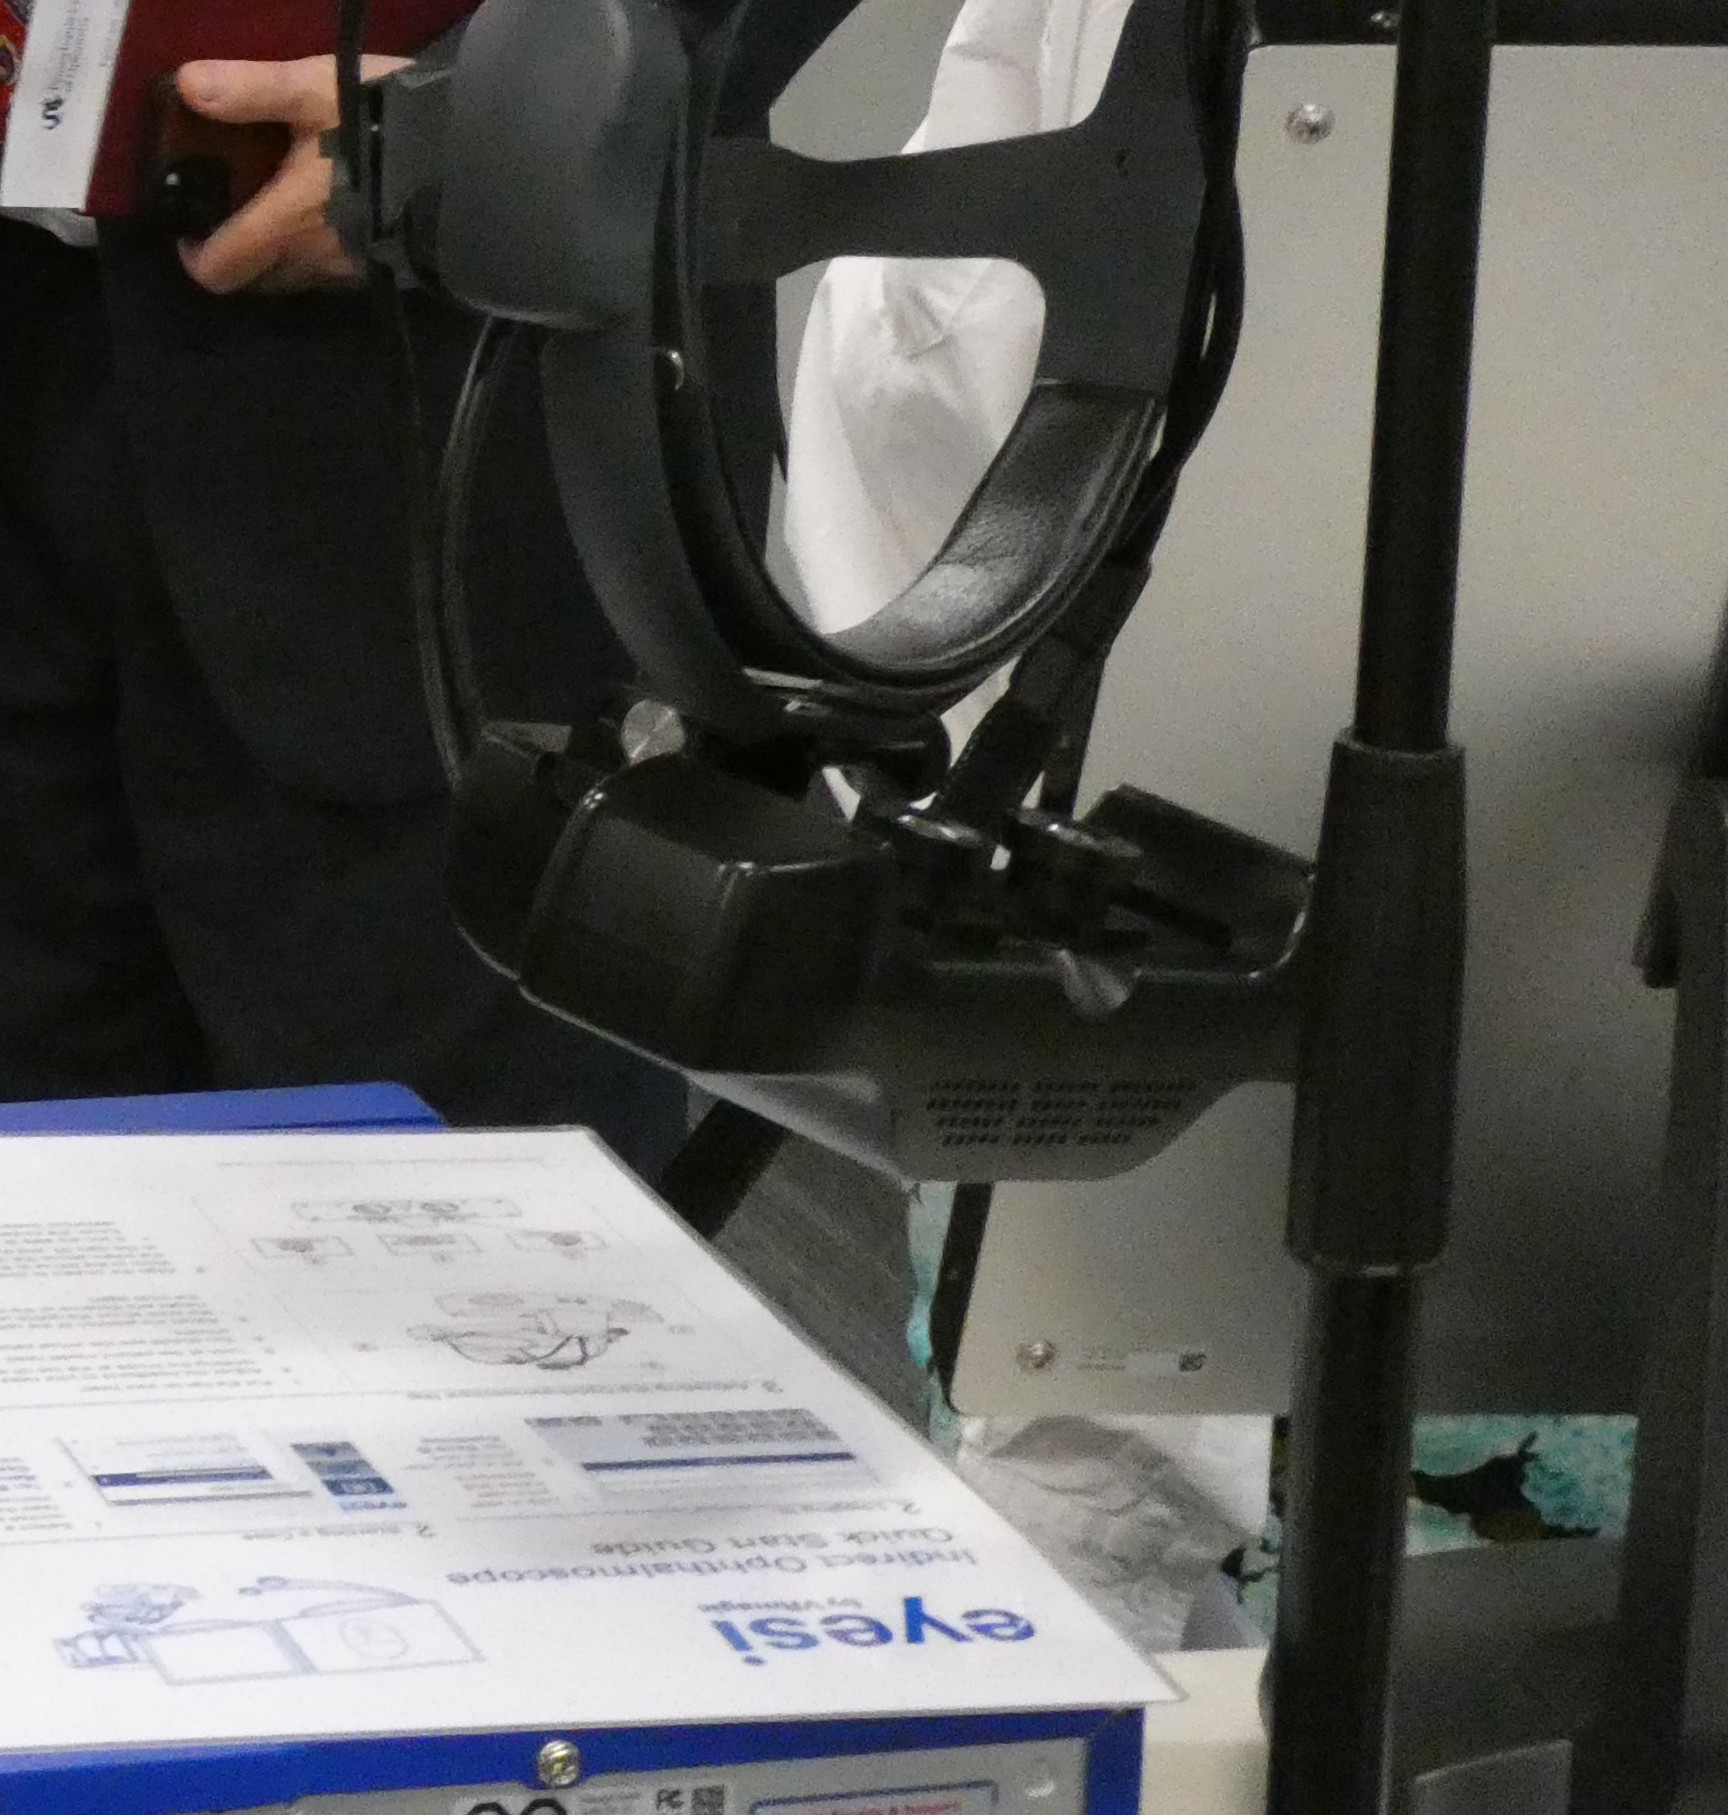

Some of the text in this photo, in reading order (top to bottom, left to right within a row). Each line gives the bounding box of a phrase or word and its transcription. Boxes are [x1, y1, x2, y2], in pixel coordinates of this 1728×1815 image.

[593, 1527, 954, 1556] Quick Start Guide
[445, 1549, 978, 1588] Indirect Ophthalmoscope
[709, 1595, 1036, 1667] eyesi
